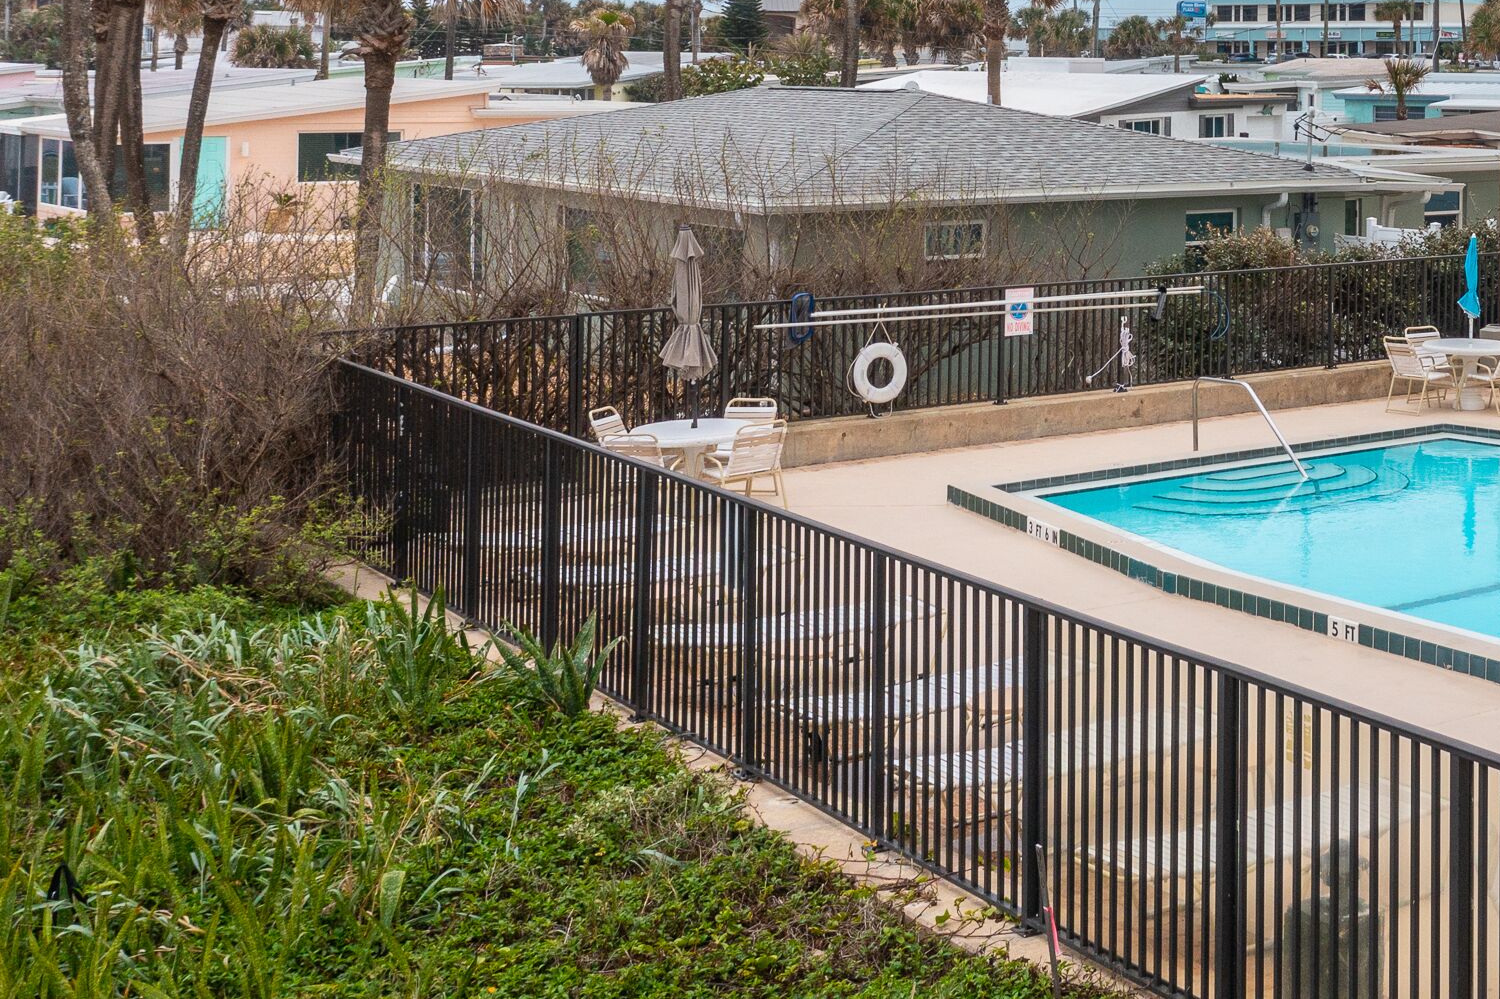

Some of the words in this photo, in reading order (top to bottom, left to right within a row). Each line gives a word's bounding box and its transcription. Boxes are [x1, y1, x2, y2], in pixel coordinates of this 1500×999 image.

[1029, 521, 1033, 534] 3
[1035, 524, 1042, 538] FT
[1045, 527, 1049, 541] 6
[1052, 530, 1058, 545] IN
[1332, 621, 1338, 637] 5
[1345, 624, 1355, 642] FT
